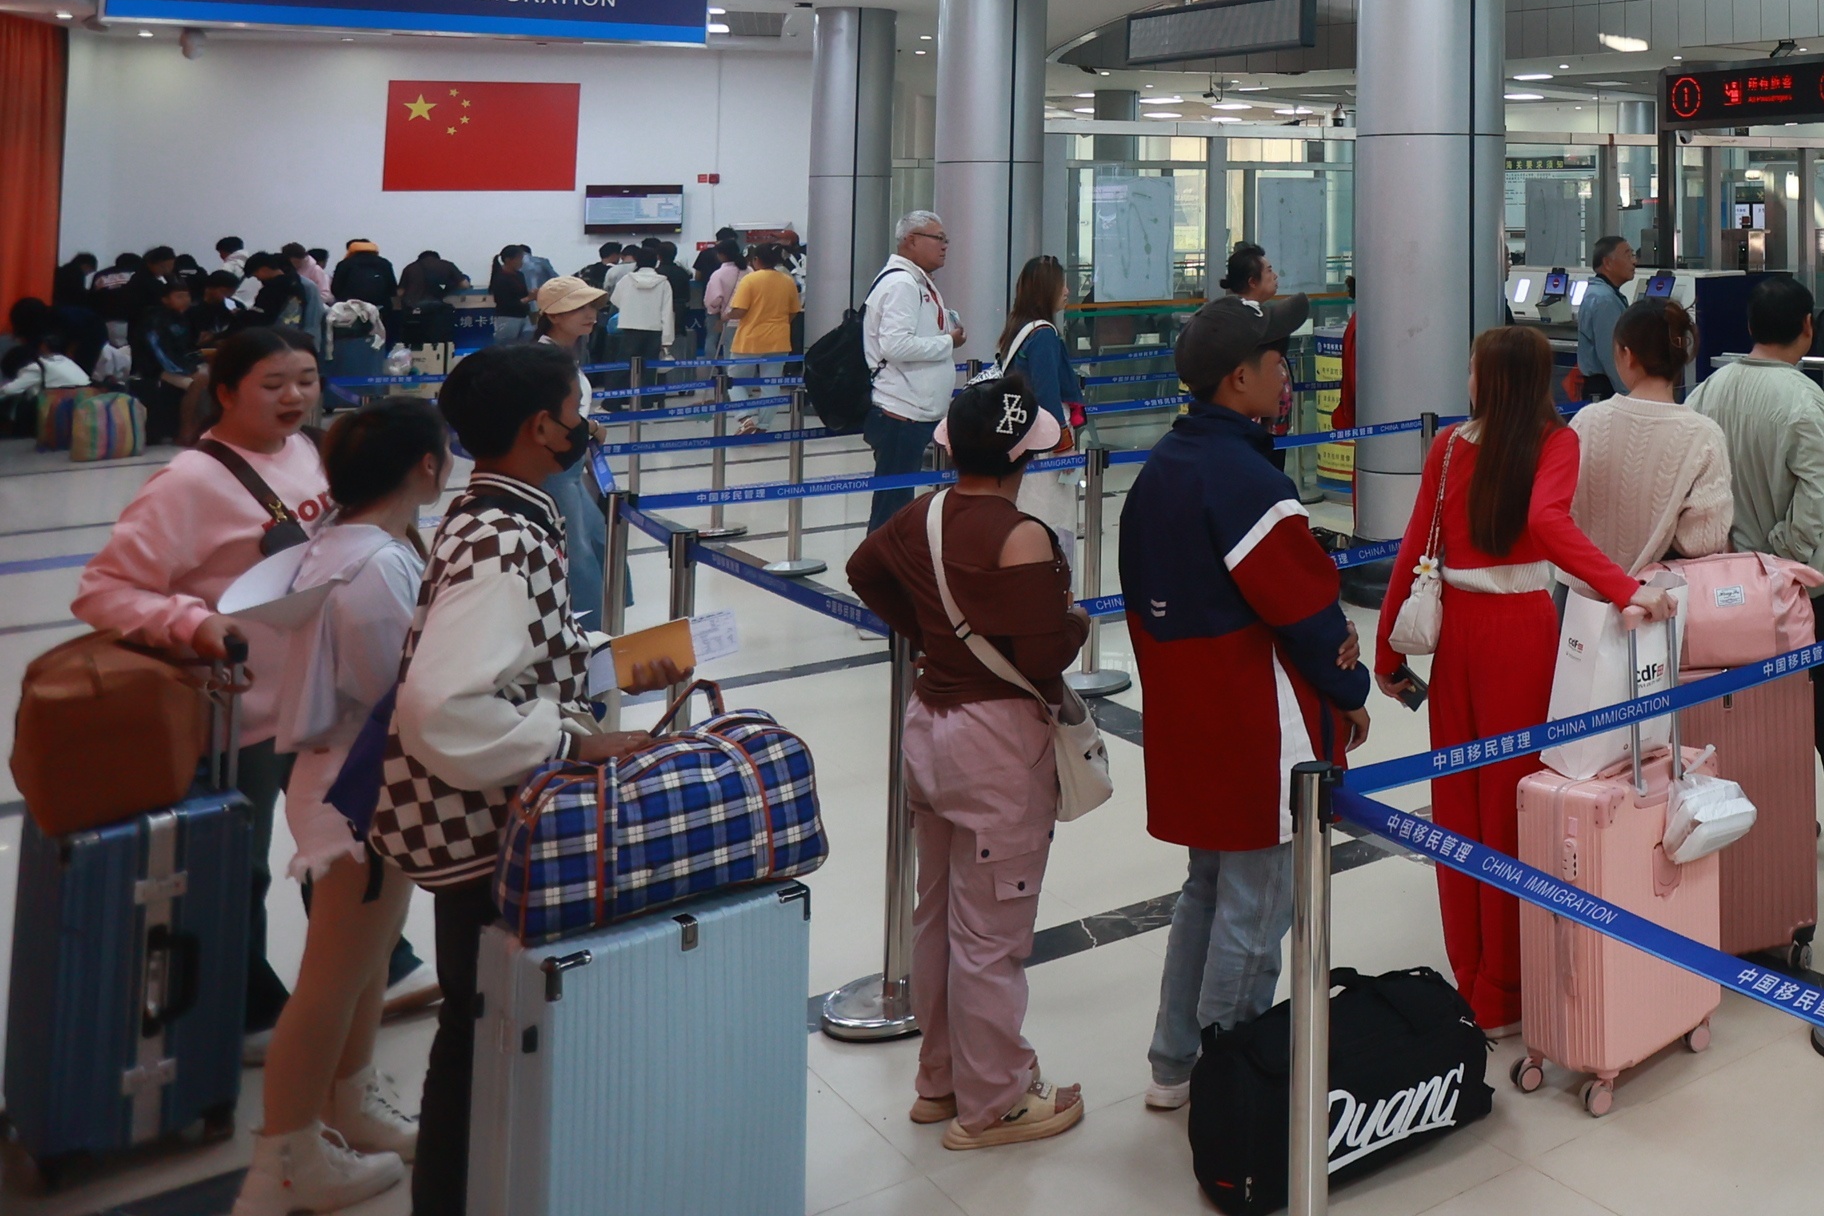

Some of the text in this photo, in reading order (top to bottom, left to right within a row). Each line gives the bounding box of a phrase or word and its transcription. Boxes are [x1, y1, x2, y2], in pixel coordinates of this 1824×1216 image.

[696, 480, 869, 502] 中国移民管理 CHINA IMMIGRATION
[1358, 546, 1385, 559] CHINA
[1433, 695, 1670, 771] 中国移民管理 CHINA IMMIGRATION
[1386, 814, 1618, 925] 中国移民管理 CHINA IMMIGRATION
